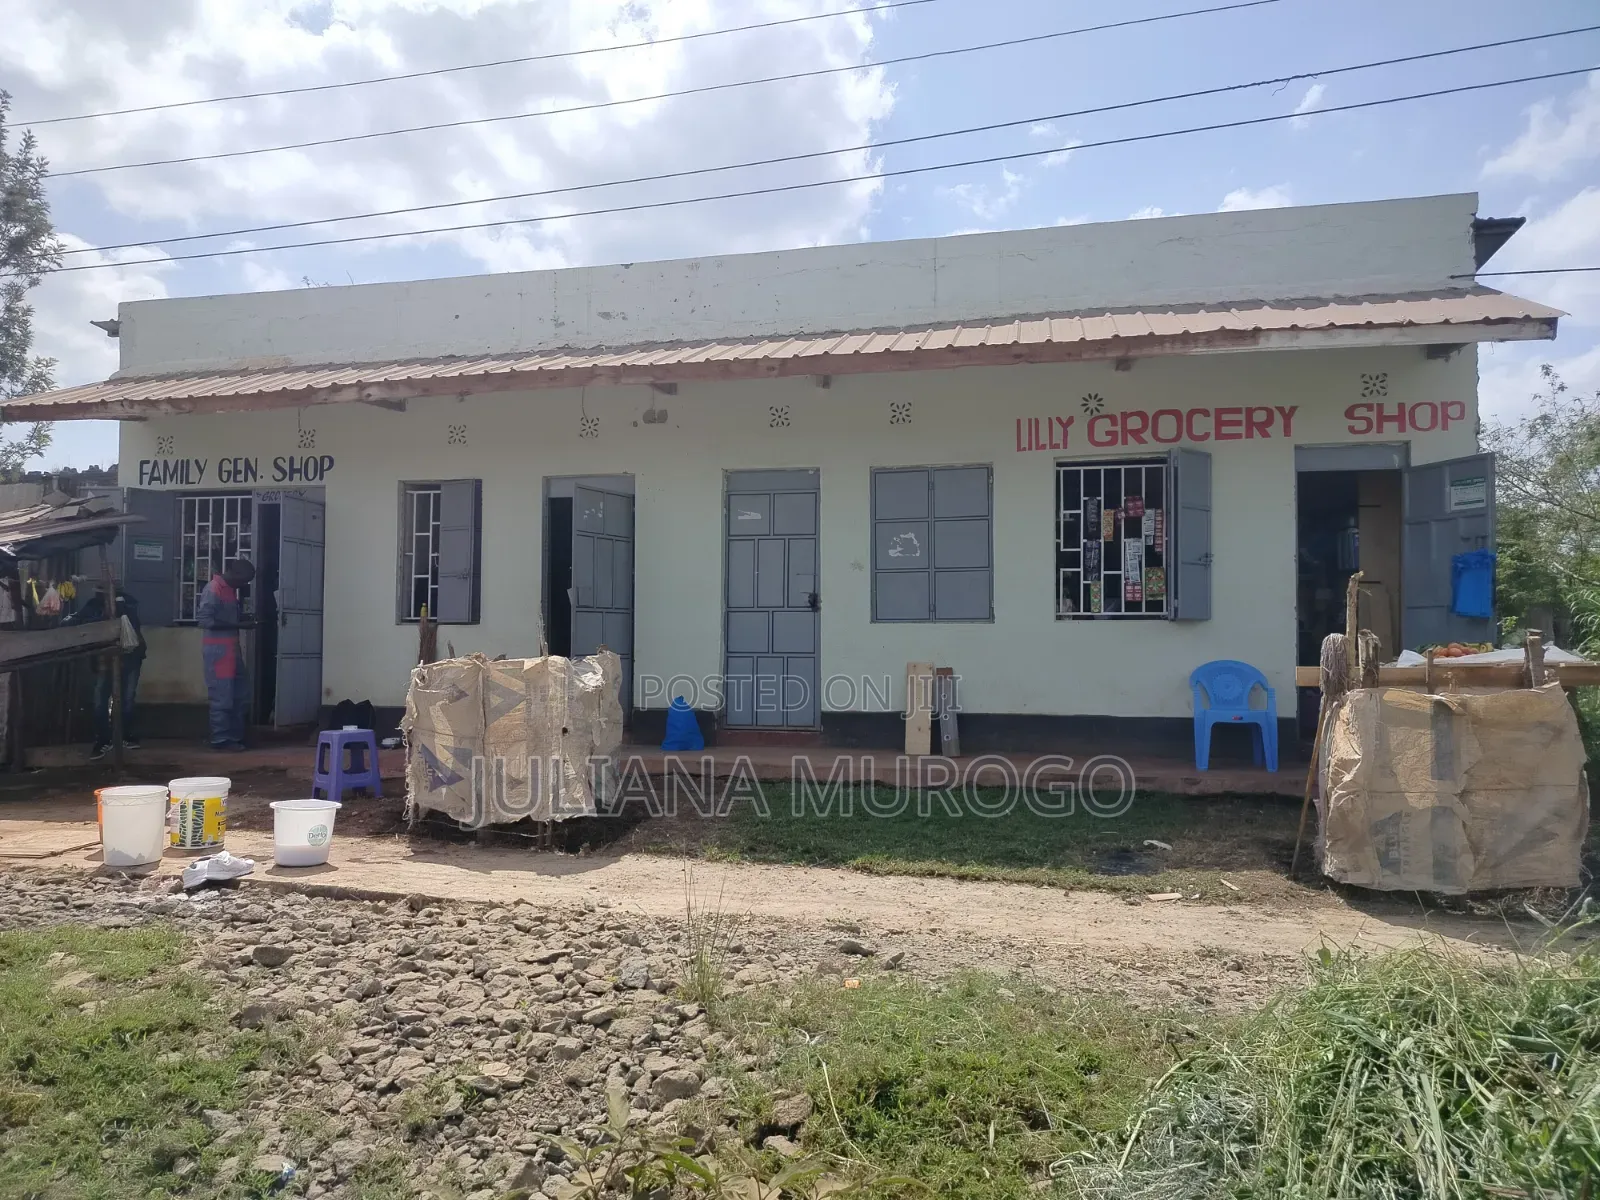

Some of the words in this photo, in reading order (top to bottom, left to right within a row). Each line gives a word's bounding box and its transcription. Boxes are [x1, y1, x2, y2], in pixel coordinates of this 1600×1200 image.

[1015, 415, 1075, 452] LILLY
[1086, 405, 1299, 448] GROCERY
[1344, 400, 1466, 435] SHOP
[138, 458, 208, 486] FAMILY
[217, 457, 264, 484] GEN.
[272, 454, 335, 483] SHOP
